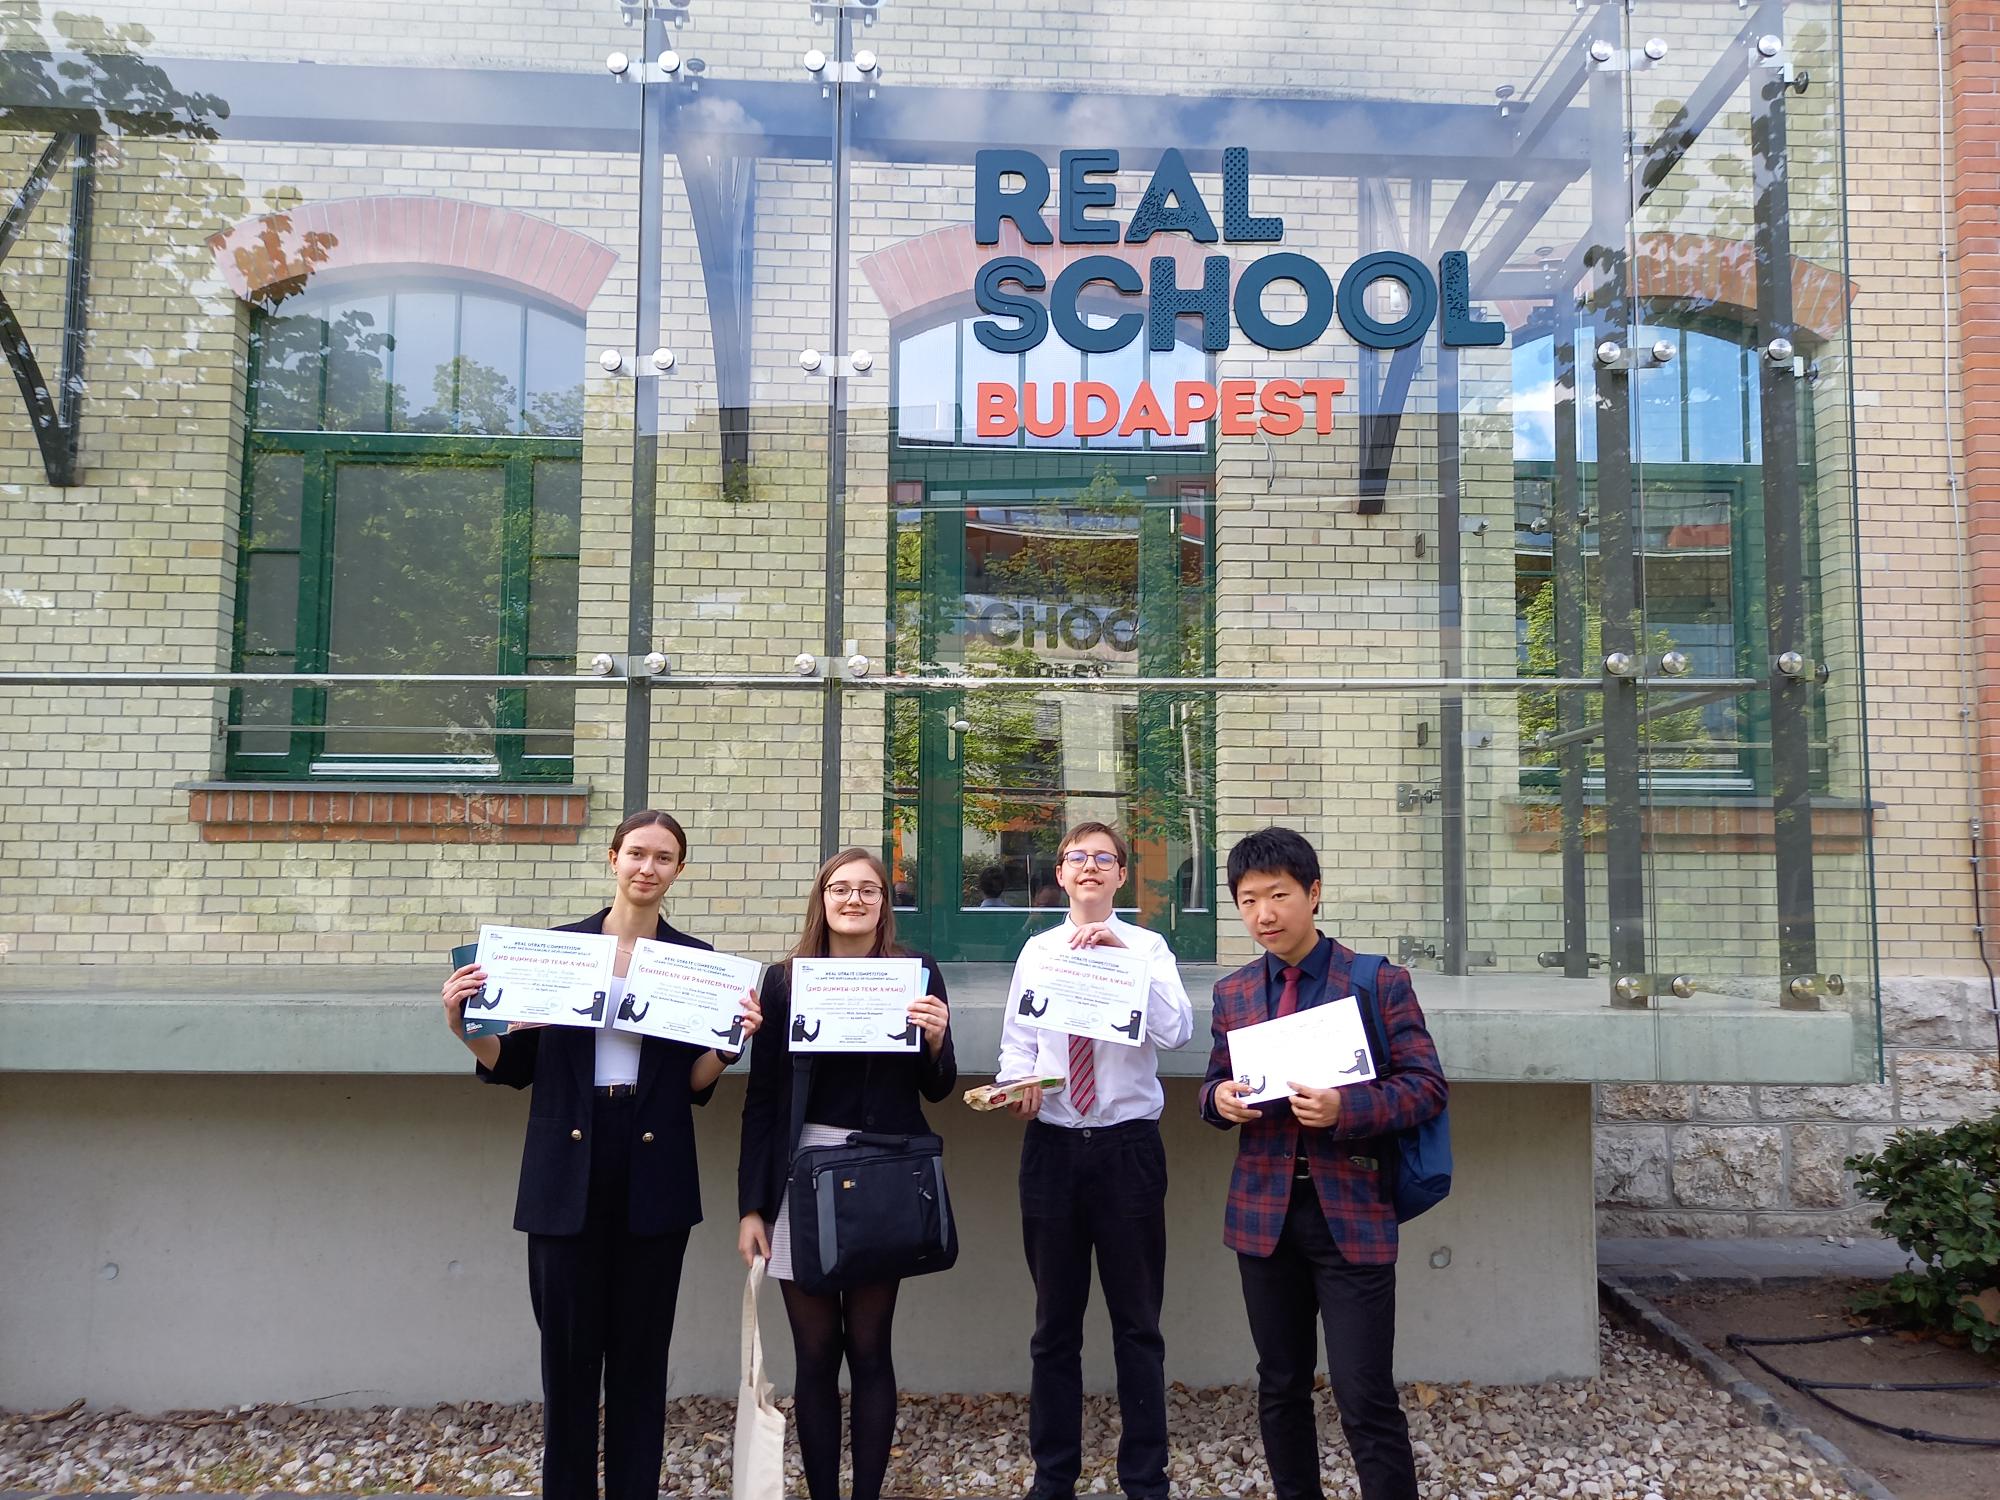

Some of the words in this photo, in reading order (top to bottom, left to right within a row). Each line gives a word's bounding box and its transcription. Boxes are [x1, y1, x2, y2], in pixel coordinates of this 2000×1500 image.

[975, 146, 1283, 246] REAL
[973, 250, 1506, 354] SCHOOL
[976, 378, 1346, 438] BUDAPEST
